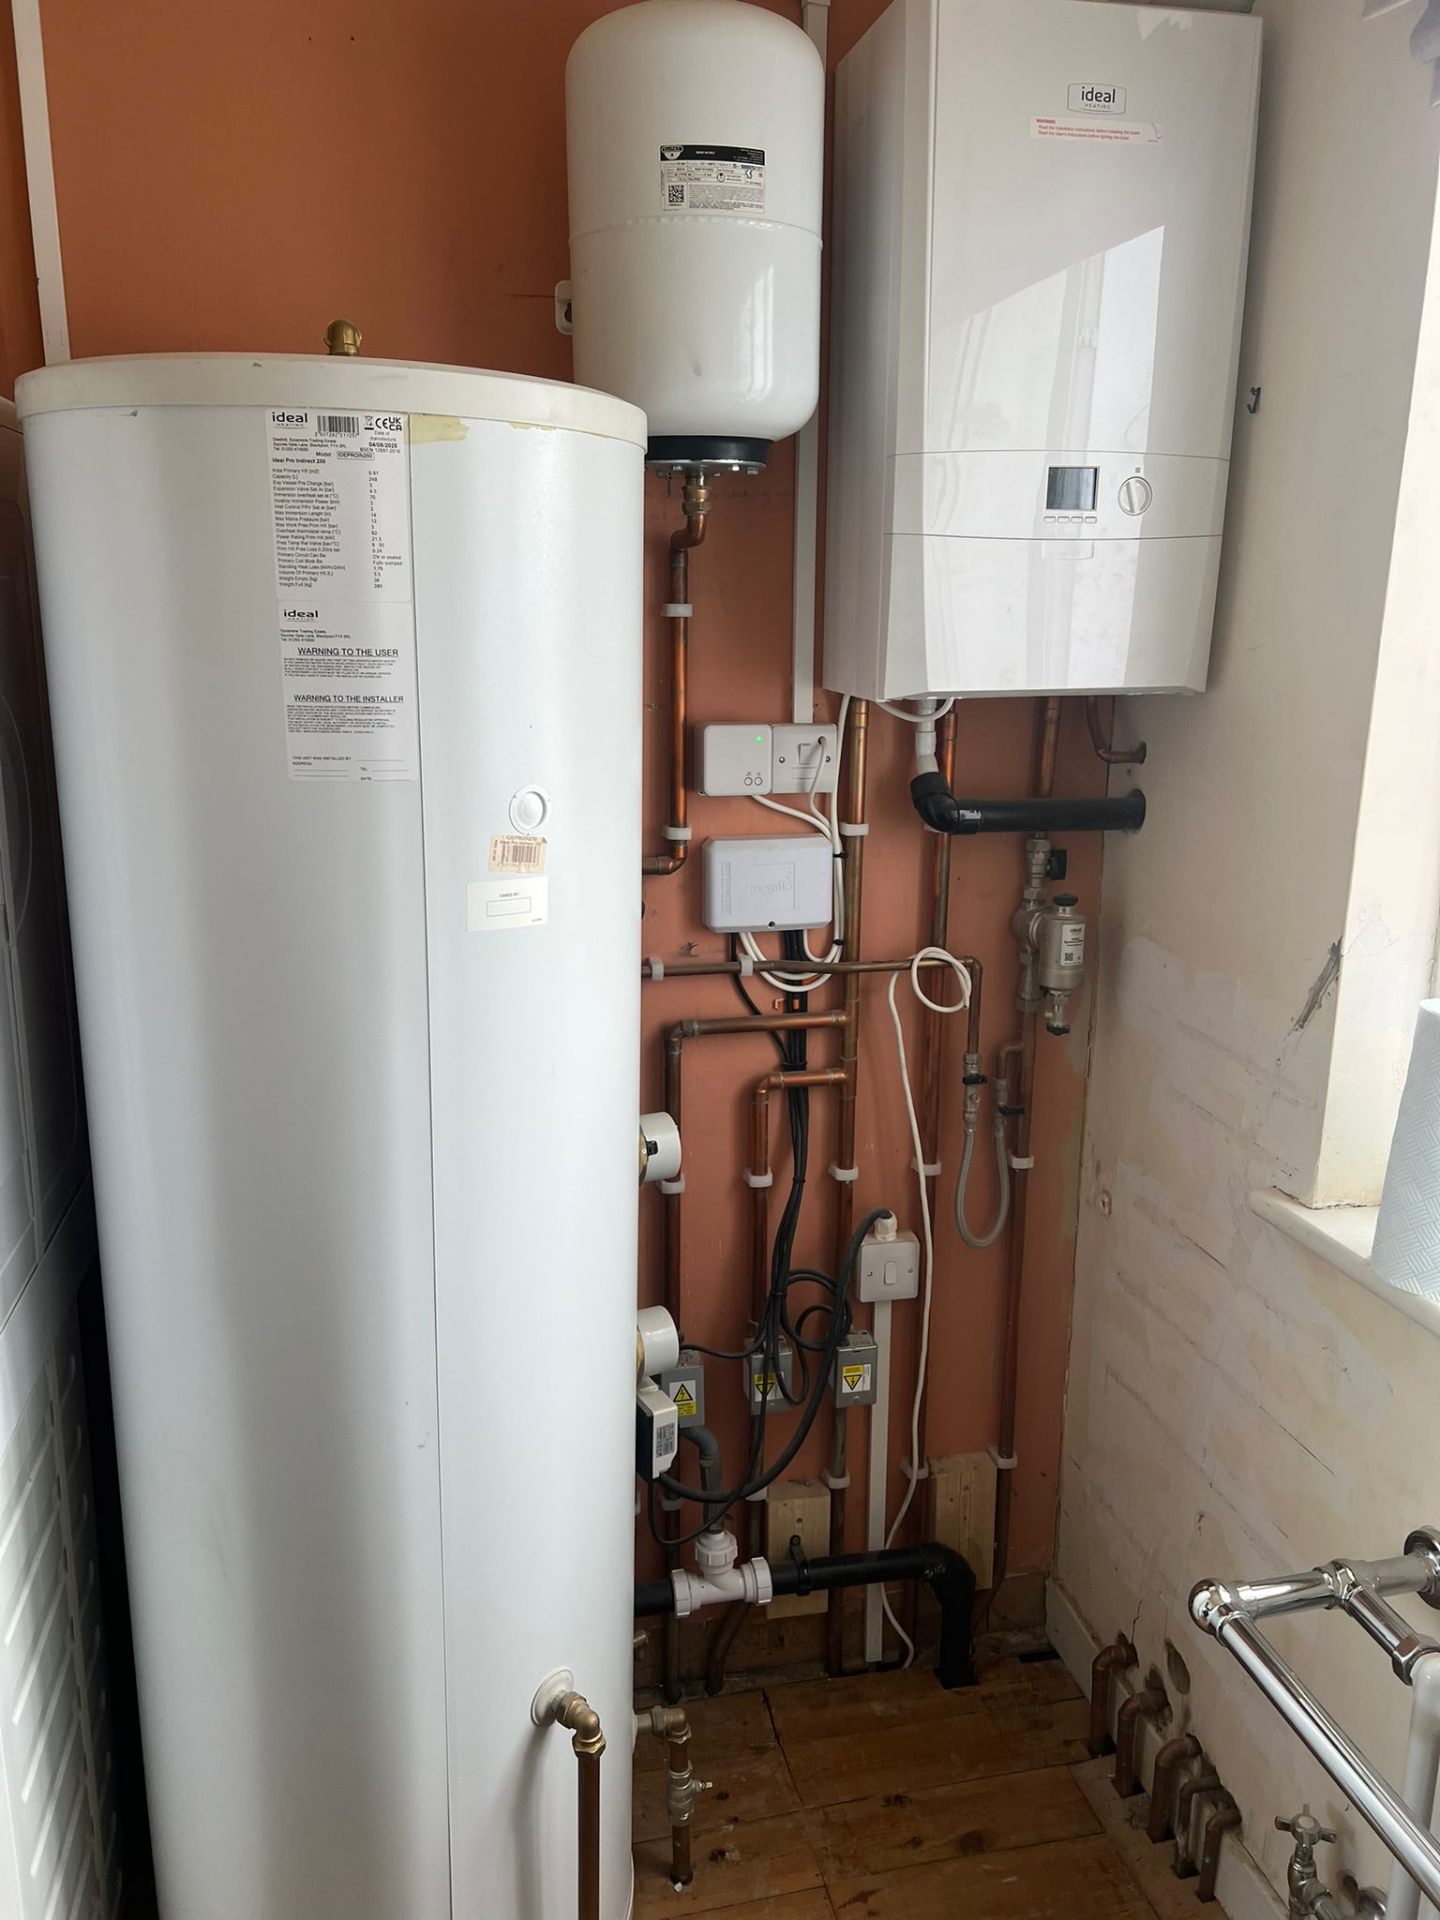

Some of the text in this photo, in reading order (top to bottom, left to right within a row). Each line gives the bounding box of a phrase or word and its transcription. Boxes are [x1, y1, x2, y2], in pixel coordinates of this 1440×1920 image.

[1082, 86, 1116, 103] ideal
[272, 412, 308, 423] ideal
[284, 609, 319, 618] ideal
[297, 647, 339, 656] WARNING
[342, 648, 353, 656] TO
[293, 694, 331, 702] WARNING
